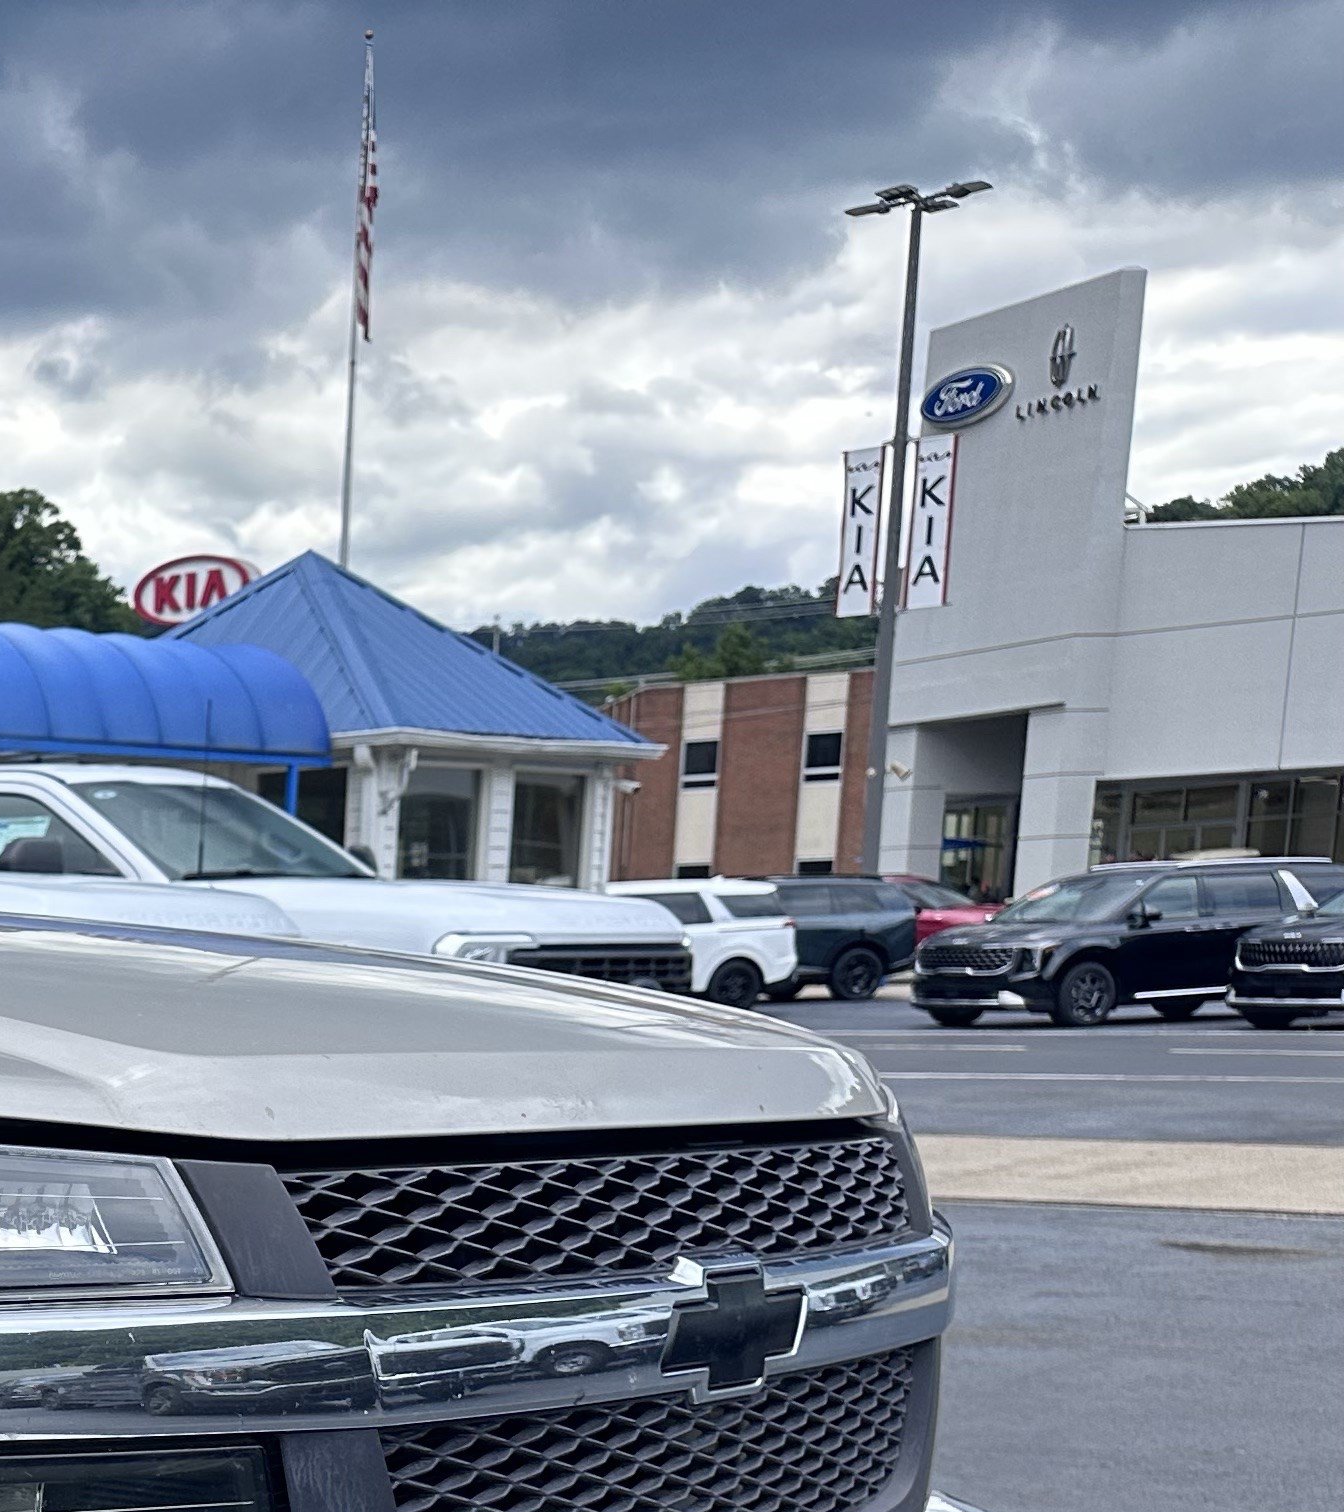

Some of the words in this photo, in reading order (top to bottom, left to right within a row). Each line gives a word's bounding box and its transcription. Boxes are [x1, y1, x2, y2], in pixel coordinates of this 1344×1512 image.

[933, 378, 986, 417] Ford
[1015, 384, 1100, 423] LINCOLN
[843, 484, 876, 595] KIA
[912, 474, 947, 587] KIA
[153, 568, 228, 614] KIA
